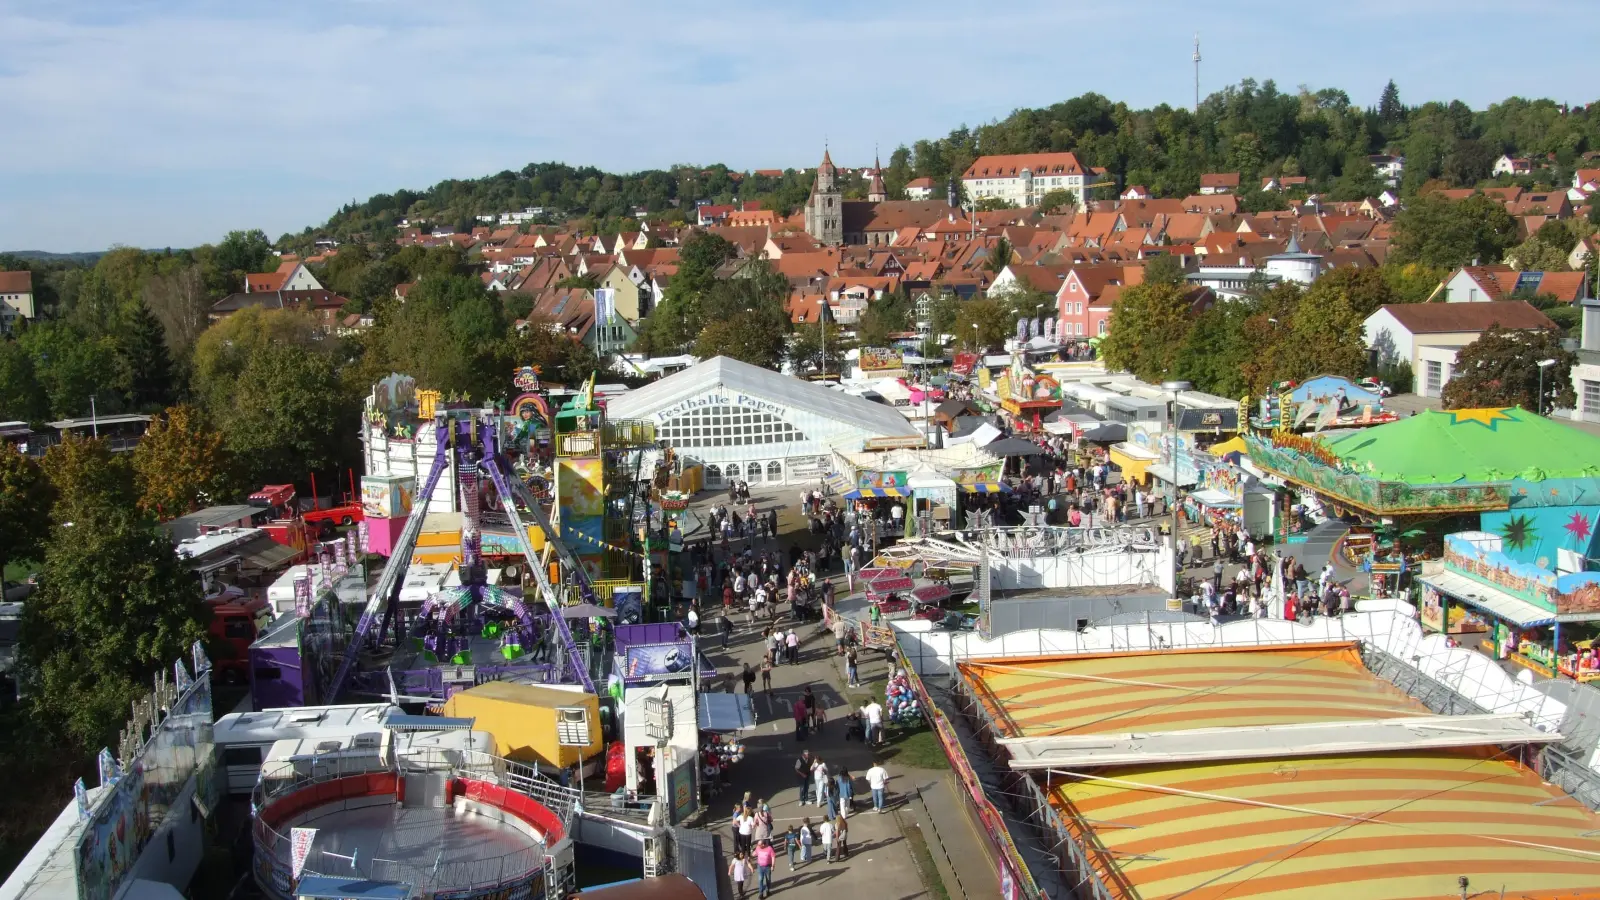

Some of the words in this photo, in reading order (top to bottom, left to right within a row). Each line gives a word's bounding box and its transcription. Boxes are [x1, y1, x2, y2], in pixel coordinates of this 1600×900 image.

[657, 394, 730, 421] Festhalle
[737, 394, 787, 417] Papert
[1281, 398, 1292, 427] ADAC
